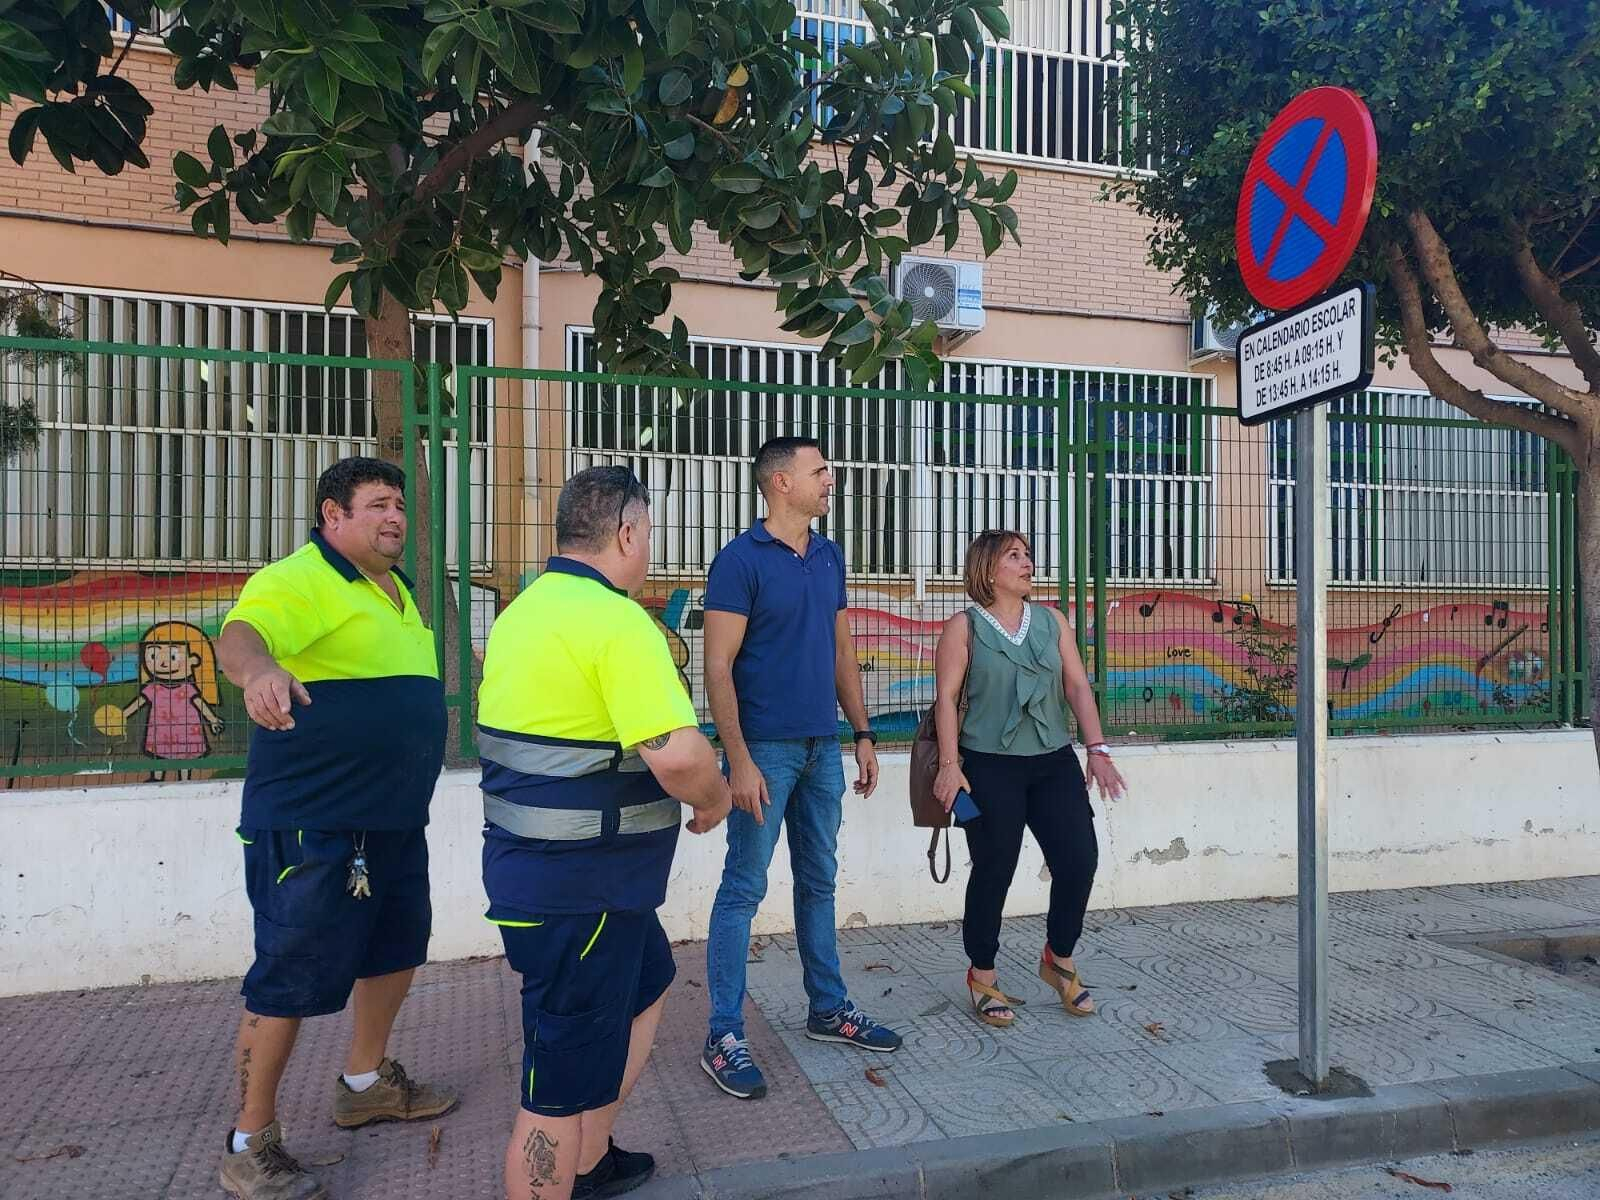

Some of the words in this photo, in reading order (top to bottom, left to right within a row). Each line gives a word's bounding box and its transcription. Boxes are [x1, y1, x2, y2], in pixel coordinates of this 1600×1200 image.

[1244, 342, 1255, 361] EN
[1256, 318, 1310, 356] CALENDARIO
[1312, 297, 1356, 334] ESCOLAR
[1254, 363, 1265, 383] DE
[1266, 356, 1283, 378] 8:45
[1284, 351, 1293, 371] H.
[1294, 349, 1301, 367] A
[1301, 338, 1324, 364] 09:15
[1326, 334, 1335, 355] H.
[1337, 329, 1344, 350] Y
[1256, 387, 1267, 407] DE
[1268, 379, 1289, 402] 13:45
[1290, 375, 1299, 395] H.
[1300, 372, 1307, 392] A
[1308, 363, 1331, 389] 14:15
[1332, 359, 1342, 380] H.
